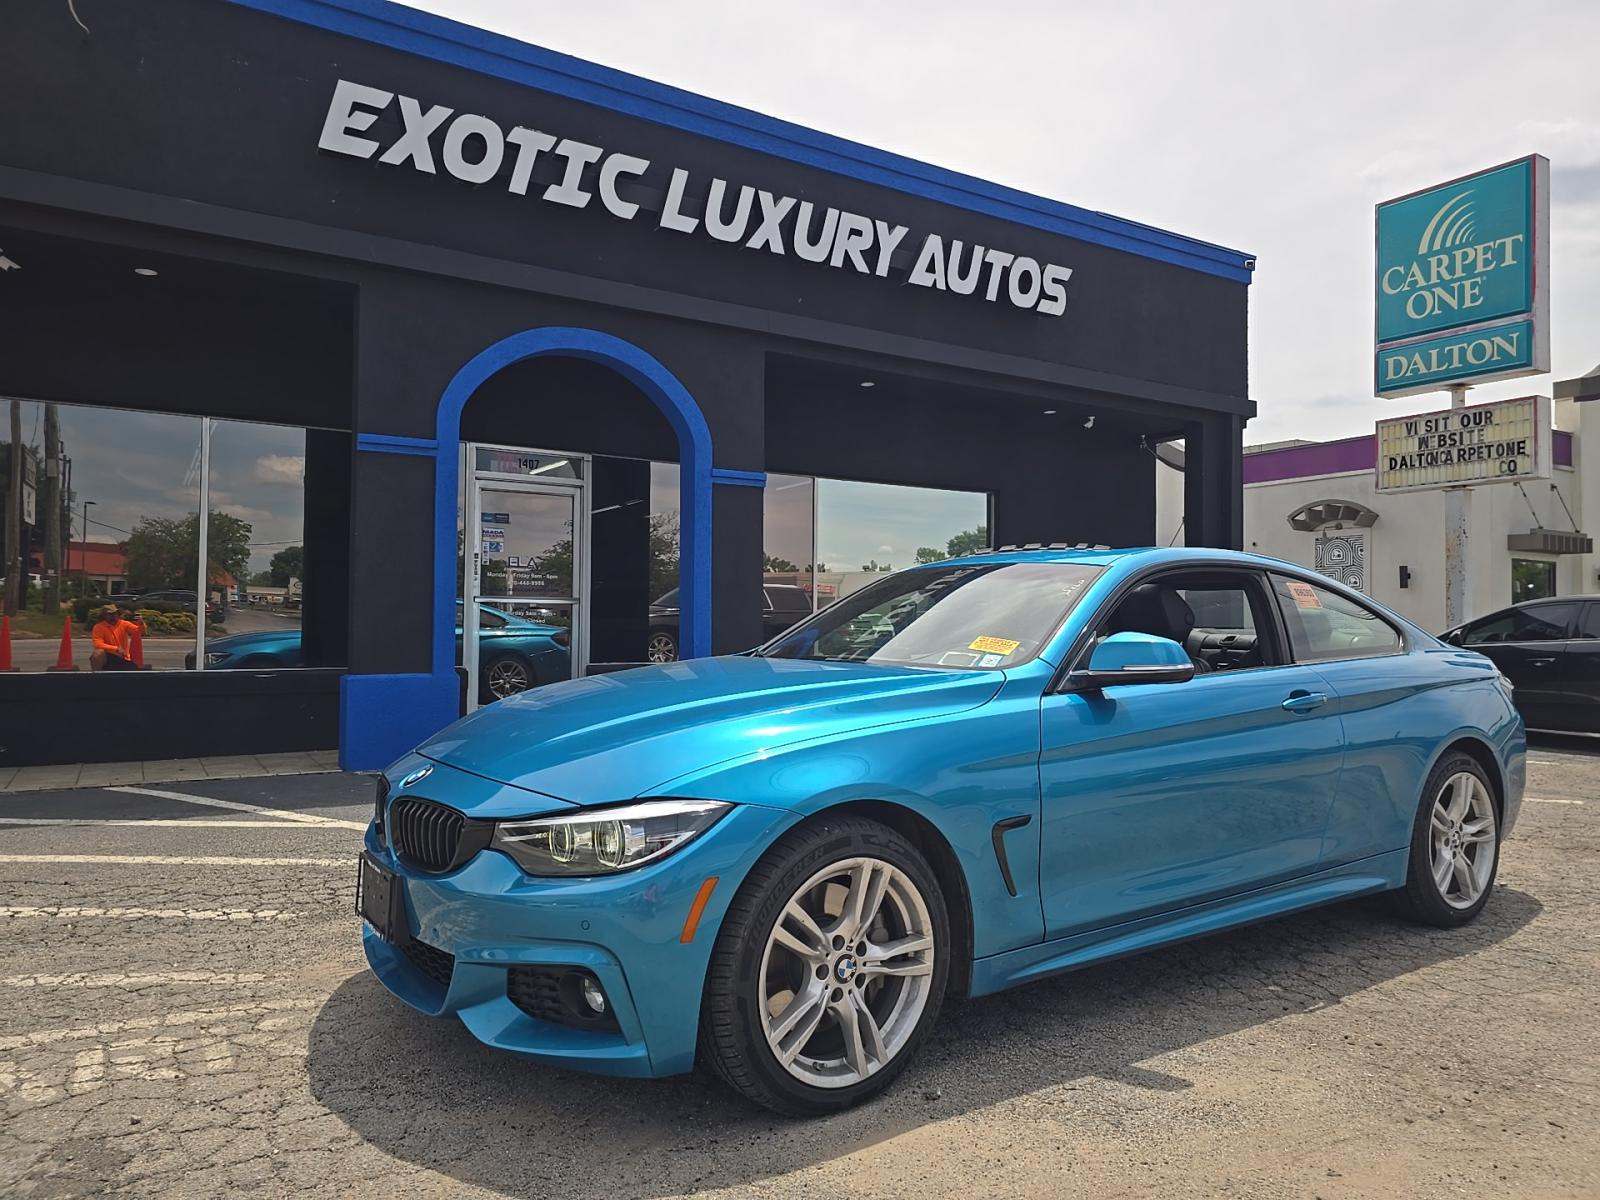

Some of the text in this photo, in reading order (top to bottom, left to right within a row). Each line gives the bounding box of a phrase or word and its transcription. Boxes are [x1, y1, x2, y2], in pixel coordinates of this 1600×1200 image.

[317, 79, 1073, 317] EXOTIC LUXURY AUTOS
[1382, 234, 1523, 295] CARPET
[1406, 276, 1484, 319] ONE
[1385, 332, 1520, 380] DALTON
[1460, 410, 1494, 428] OUR
[1417, 428, 1485, 450] WEBSITE
[518, 458, 540, 470] 1407
[1499, 459, 1518, 474] CO
